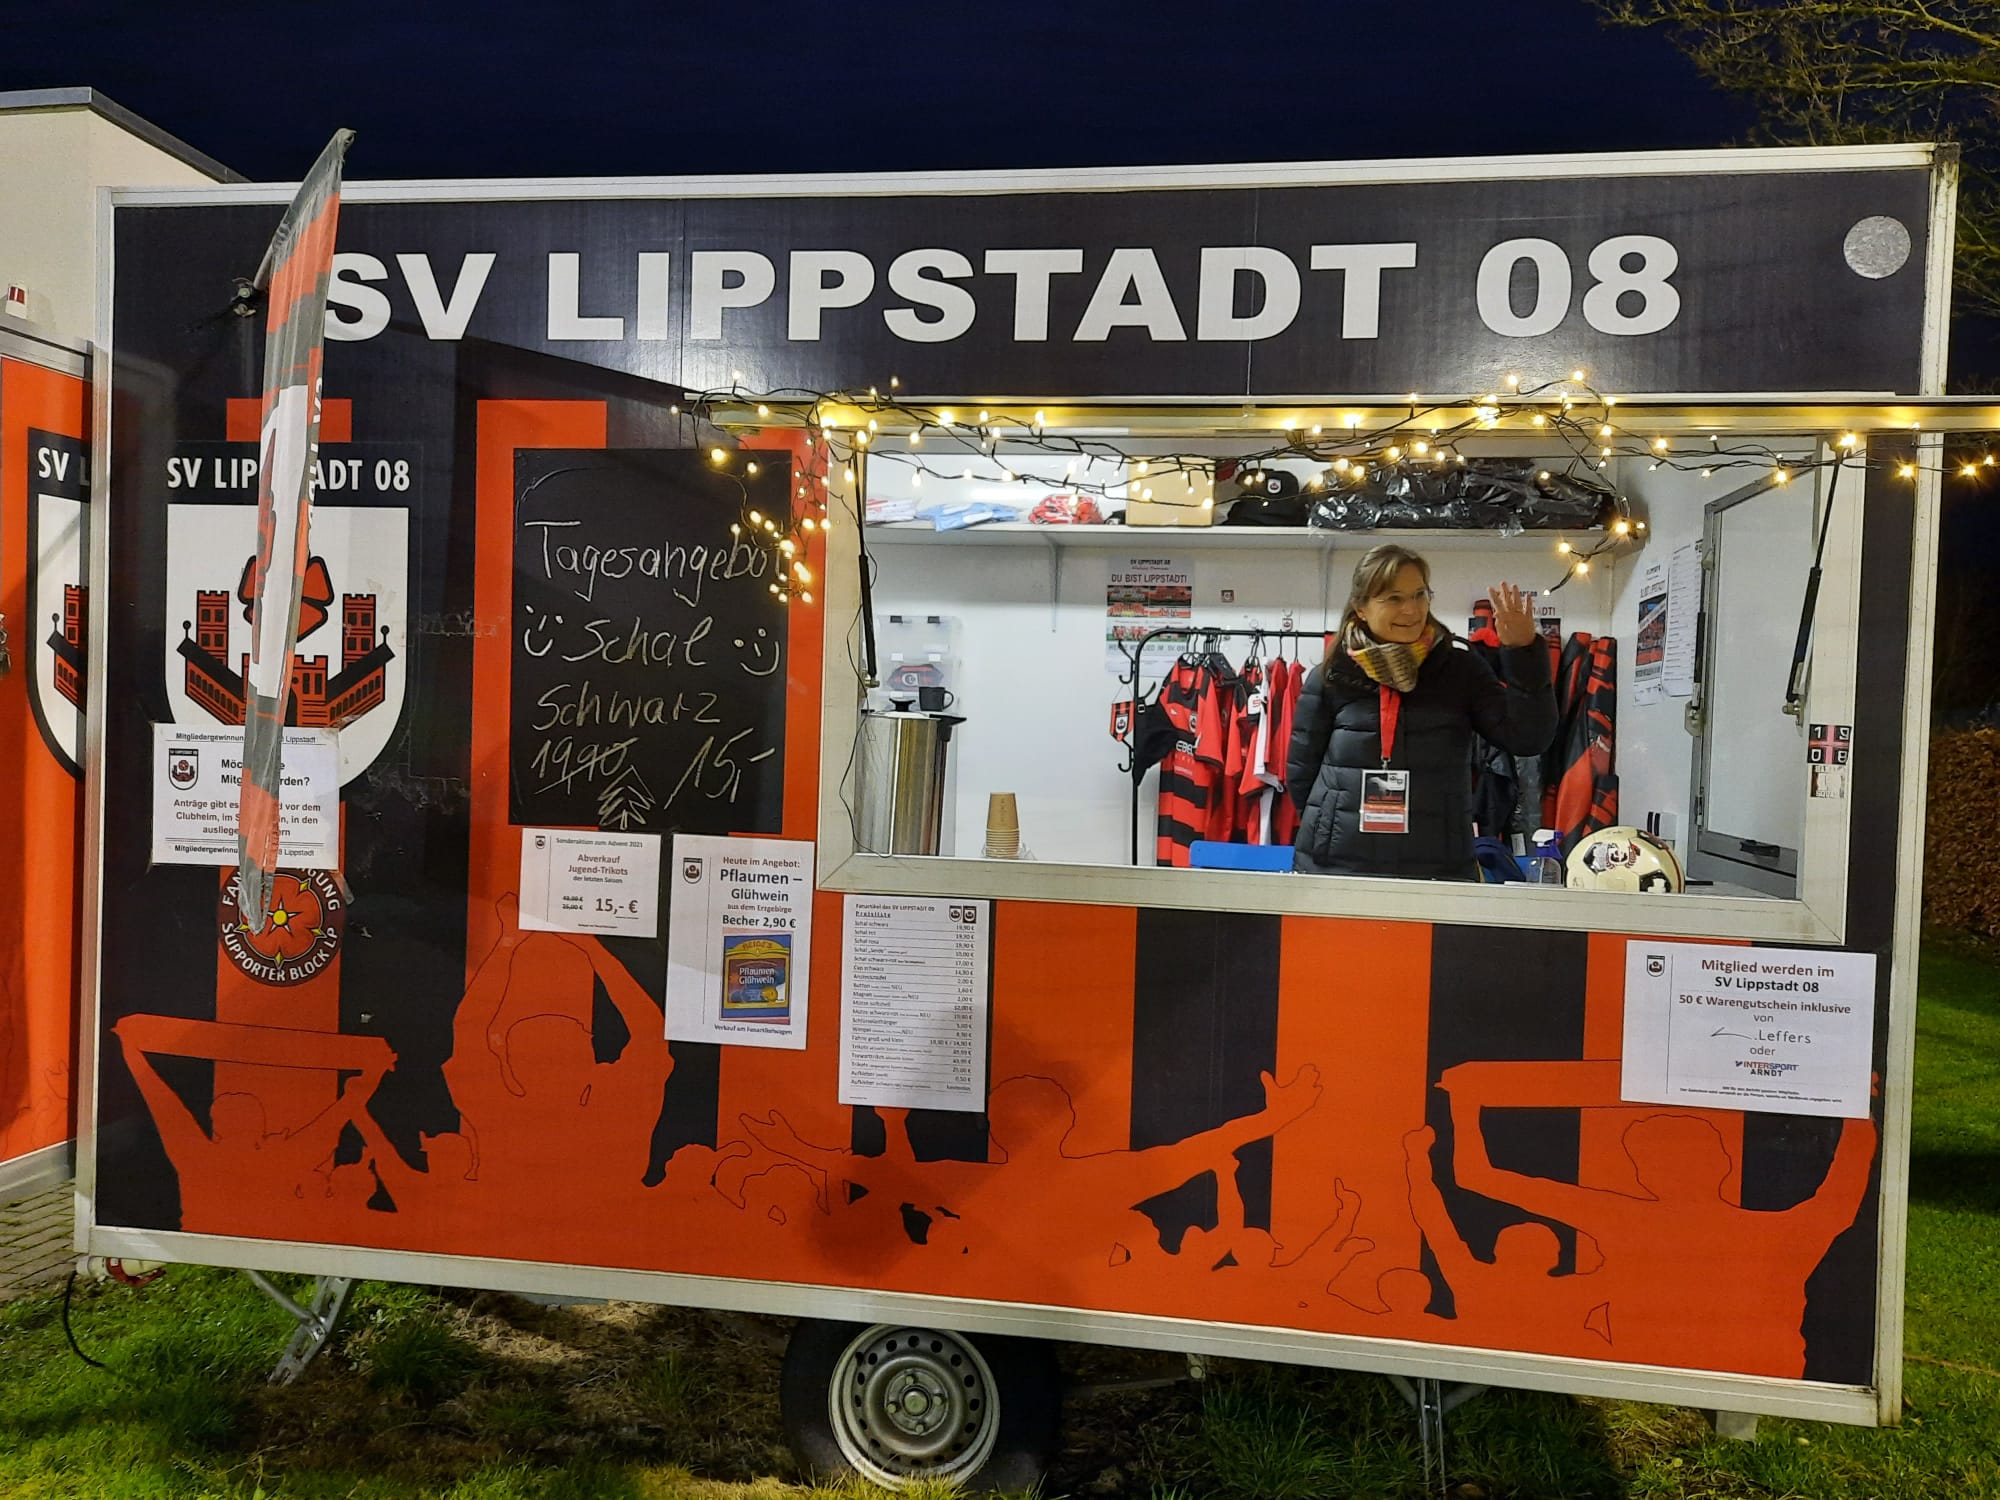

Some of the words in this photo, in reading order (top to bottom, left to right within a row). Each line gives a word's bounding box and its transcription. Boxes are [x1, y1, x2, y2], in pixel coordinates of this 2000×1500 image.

[324, 252, 497, 342] SV
[547, 242, 1417, 342] LIPPSTADT
[1476, 234, 1681, 338] 08
[38, 447, 69, 481] SV
[167, 457, 202, 490] SV
[214, 458, 363, 490] LIPADT
[375, 459, 410, 491] 08
[1111, 574, 1123, 582] DU
[1125, 574, 1142, 583] BIST
[562, 615, 714, 667] Schal
[533, 680, 720, 731] Schwarz
[176, 732, 244, 742] Mitgliedergewinnun
[285, 736, 316, 744] Lippstadt
[279, 777, 310, 786] rden?
[173, 800, 208, 810] Anträge
[210, 799, 227, 810] gibt
[302, 803, 321, 812] dem
[176, 811, 220, 822] Clubheim,
[222, 812, 233, 821] im
[291, 814, 300, 823] in
[302, 814, 318, 824] den
[202, 826, 240, 836] ausliege
[175, 844, 238, 854] Mitgliedergewinnu
[577, 854, 621, 864] Abverkauf
[722, 856, 747, 866] Heute
[749, 857, 760, 866] im
[761, 858, 800, 869] Angebot:
[568, 864, 628, 876] Jugend-Trikots
[720, 868, 789, 885] Pflaumen
[731, 888, 789, 902] Glühwein
[595, 898, 625, 915] 15,-
[628, 899, 639, 914] €
[740, 903, 756, 912] dem
[757, 904, 792, 914] Erzgebirge
[722, 915, 759, 927] Becher
[762, 916, 786, 929] 2,90
[789, 917, 797, 929] €
[222, 923, 286, 981] SUPPORTER
[289, 949, 330, 980] BLOCK
[324, 927, 338, 949] LP
[739, 967, 775, 976] Pflaumen
[1701, 959, 1758, 973] Mitglied
[1761, 964, 1813, 977] werden
[1817, 967, 1835, 978] im
[739, 975, 775, 985] Glühwein
[1714, 976, 1732, 988] SV
[1736, 977, 1799, 992] Lippstadt
[1802, 981, 1820, 993] 08
[1679, 994, 1693, 1005] 50
[1695, 995, 1703, 1005] €
[1706, 996, 1798, 1010] Warengutschein
[1800, 1002, 1851, 1014] inklusive
[1753, 1013, 1774, 1023] von
[1749, 1046, 1776, 1056] oder
[1743, 1061, 1799, 1071] INTERSPORT
[1750, 1069, 1783, 1077] ARNDT
